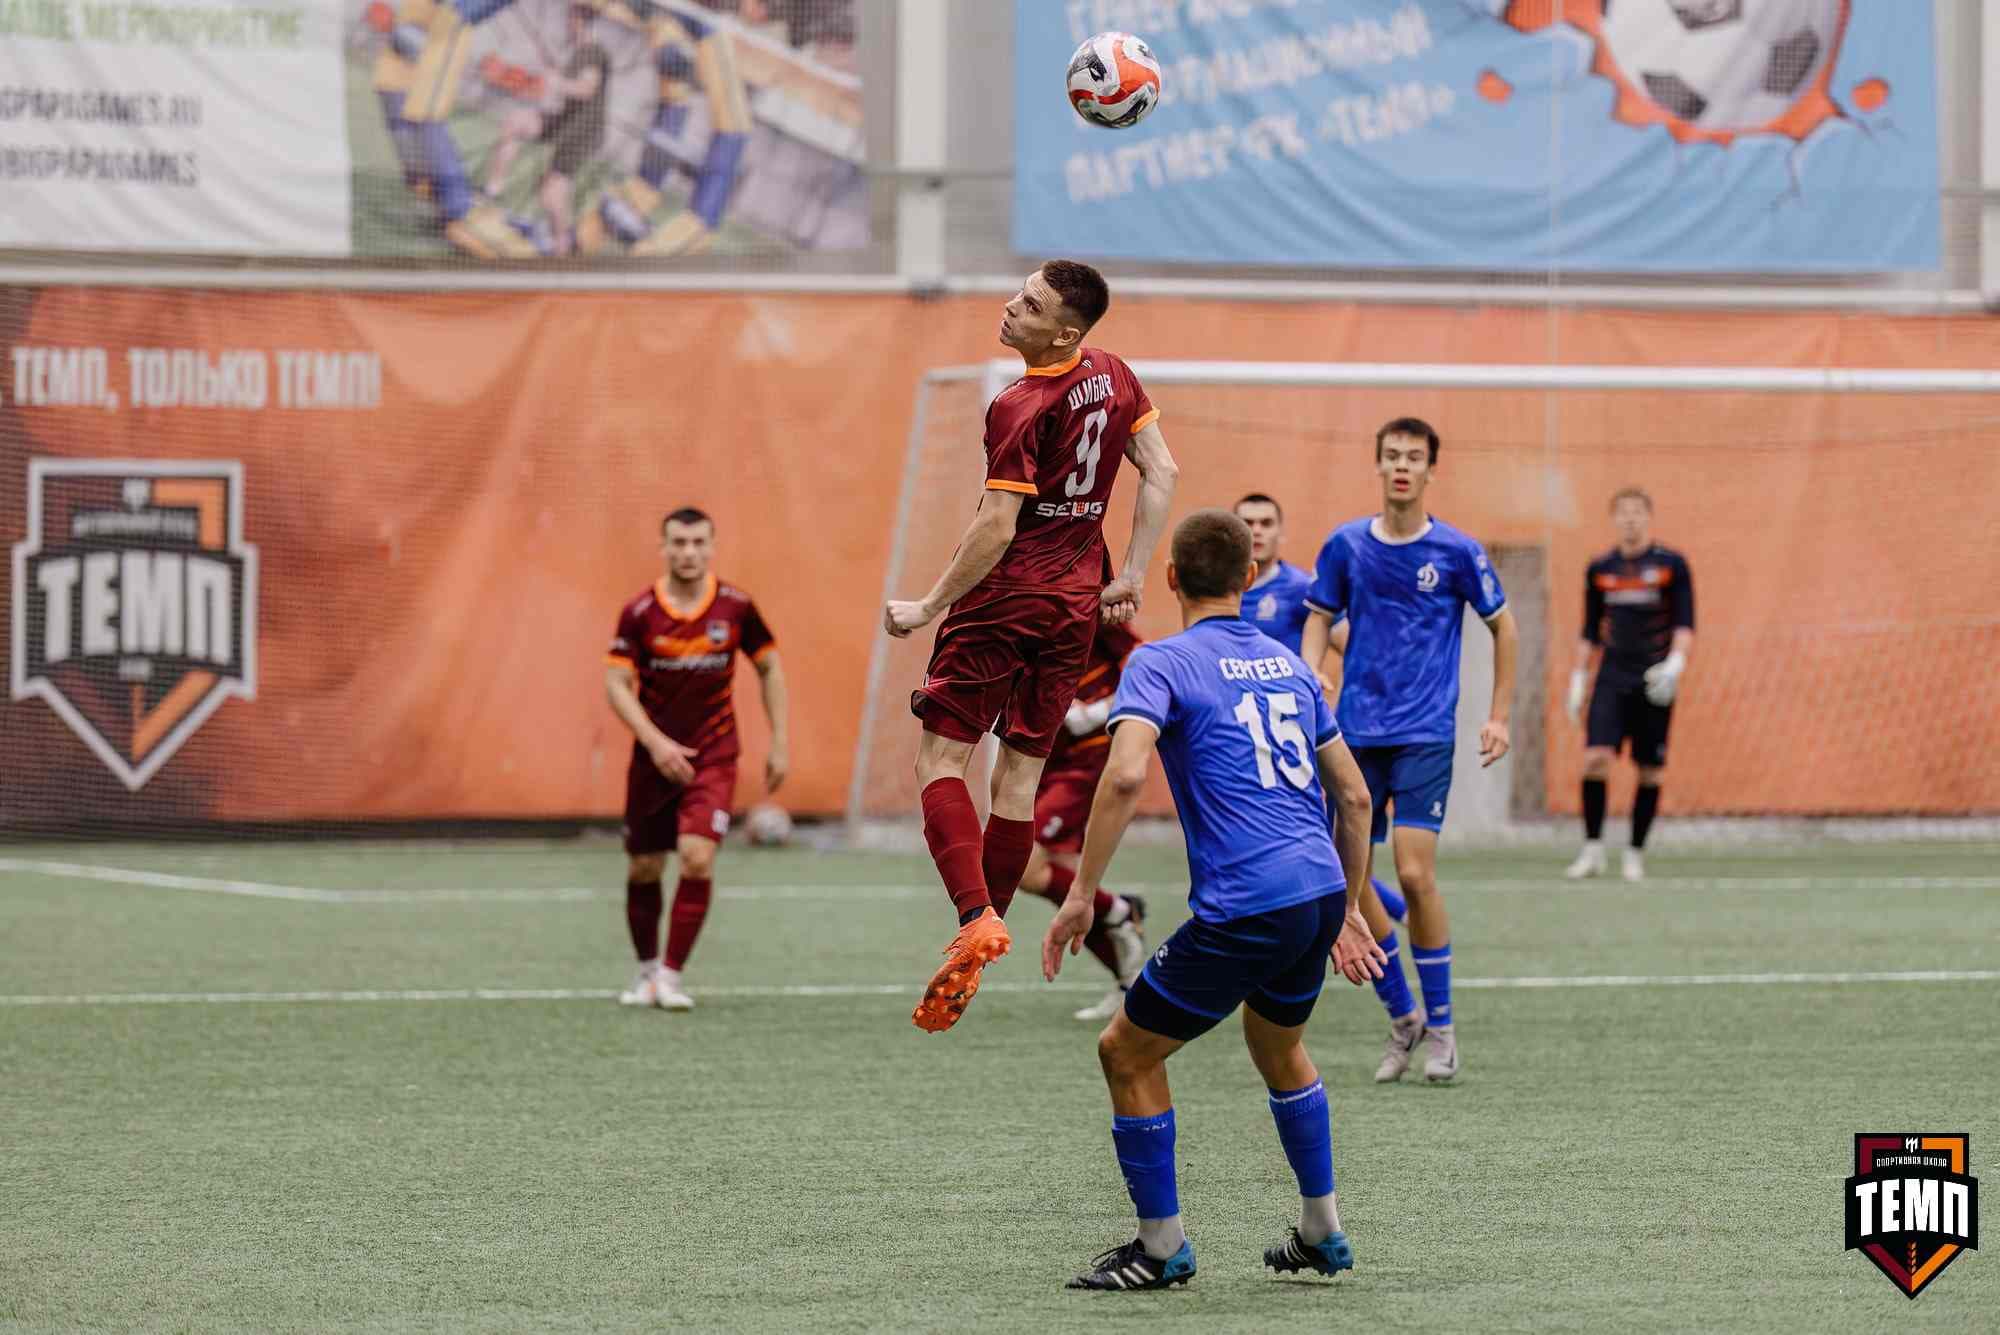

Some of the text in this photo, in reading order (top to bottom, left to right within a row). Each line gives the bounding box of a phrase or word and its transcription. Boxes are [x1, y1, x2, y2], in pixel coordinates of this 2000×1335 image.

[13, 346, 118, 413] ТЕМП,
[128, 347, 268, 409] ТОЛЬКО
[1065, 407, 1107, 498] 9
[37, 551, 233, 664] ТЕМП
[1233, 691, 1315, 790] 15
